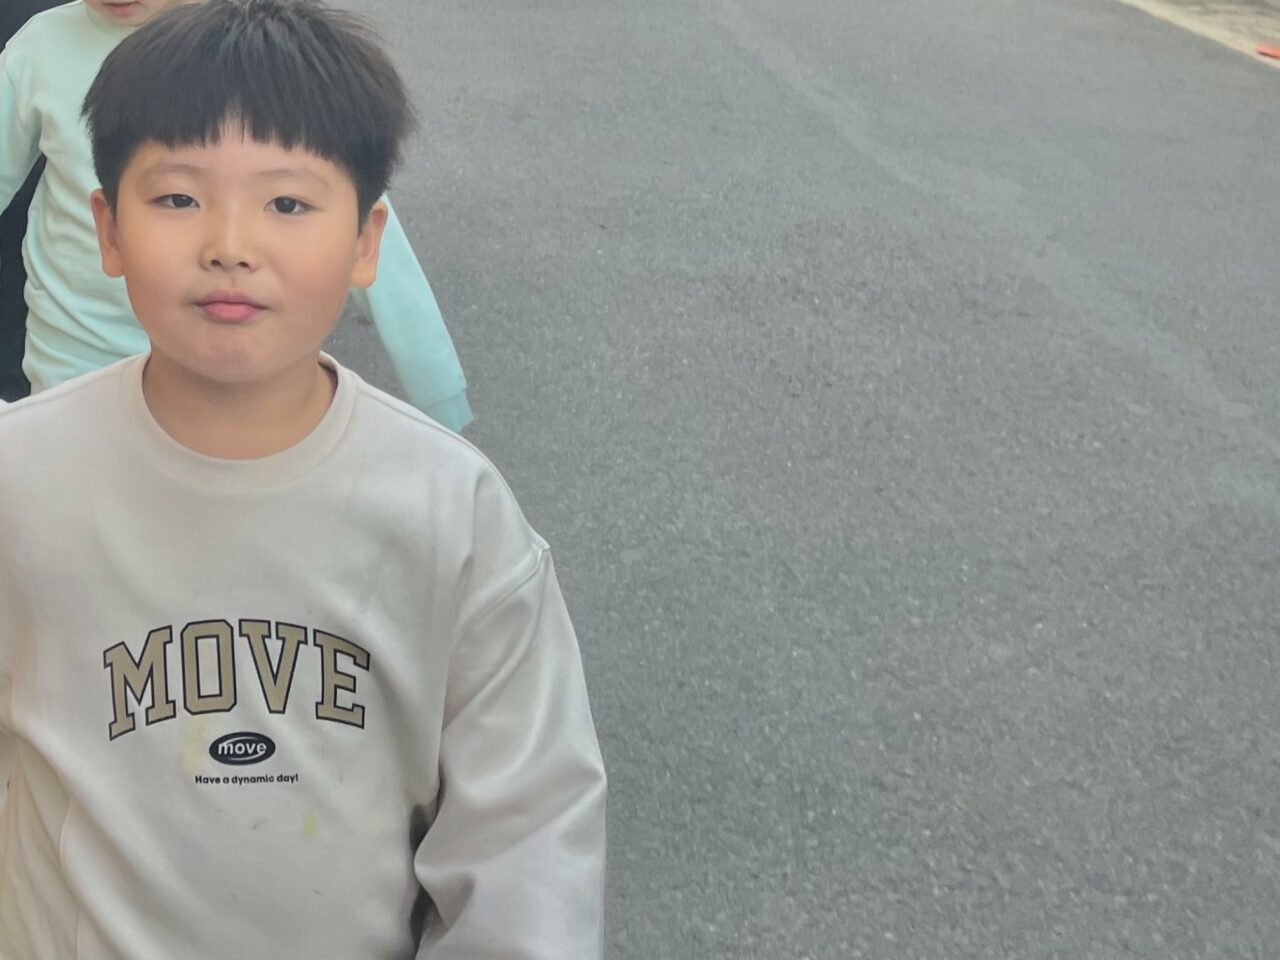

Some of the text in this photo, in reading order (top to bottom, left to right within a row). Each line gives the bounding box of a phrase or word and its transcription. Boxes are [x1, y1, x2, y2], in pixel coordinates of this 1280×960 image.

[103, 618, 371, 742] MOVE
[217, 741, 268, 756] move
[195, 775, 221, 784] Have
[231, 774, 275, 786] dynamic
[276, 773, 299, 785] day!
